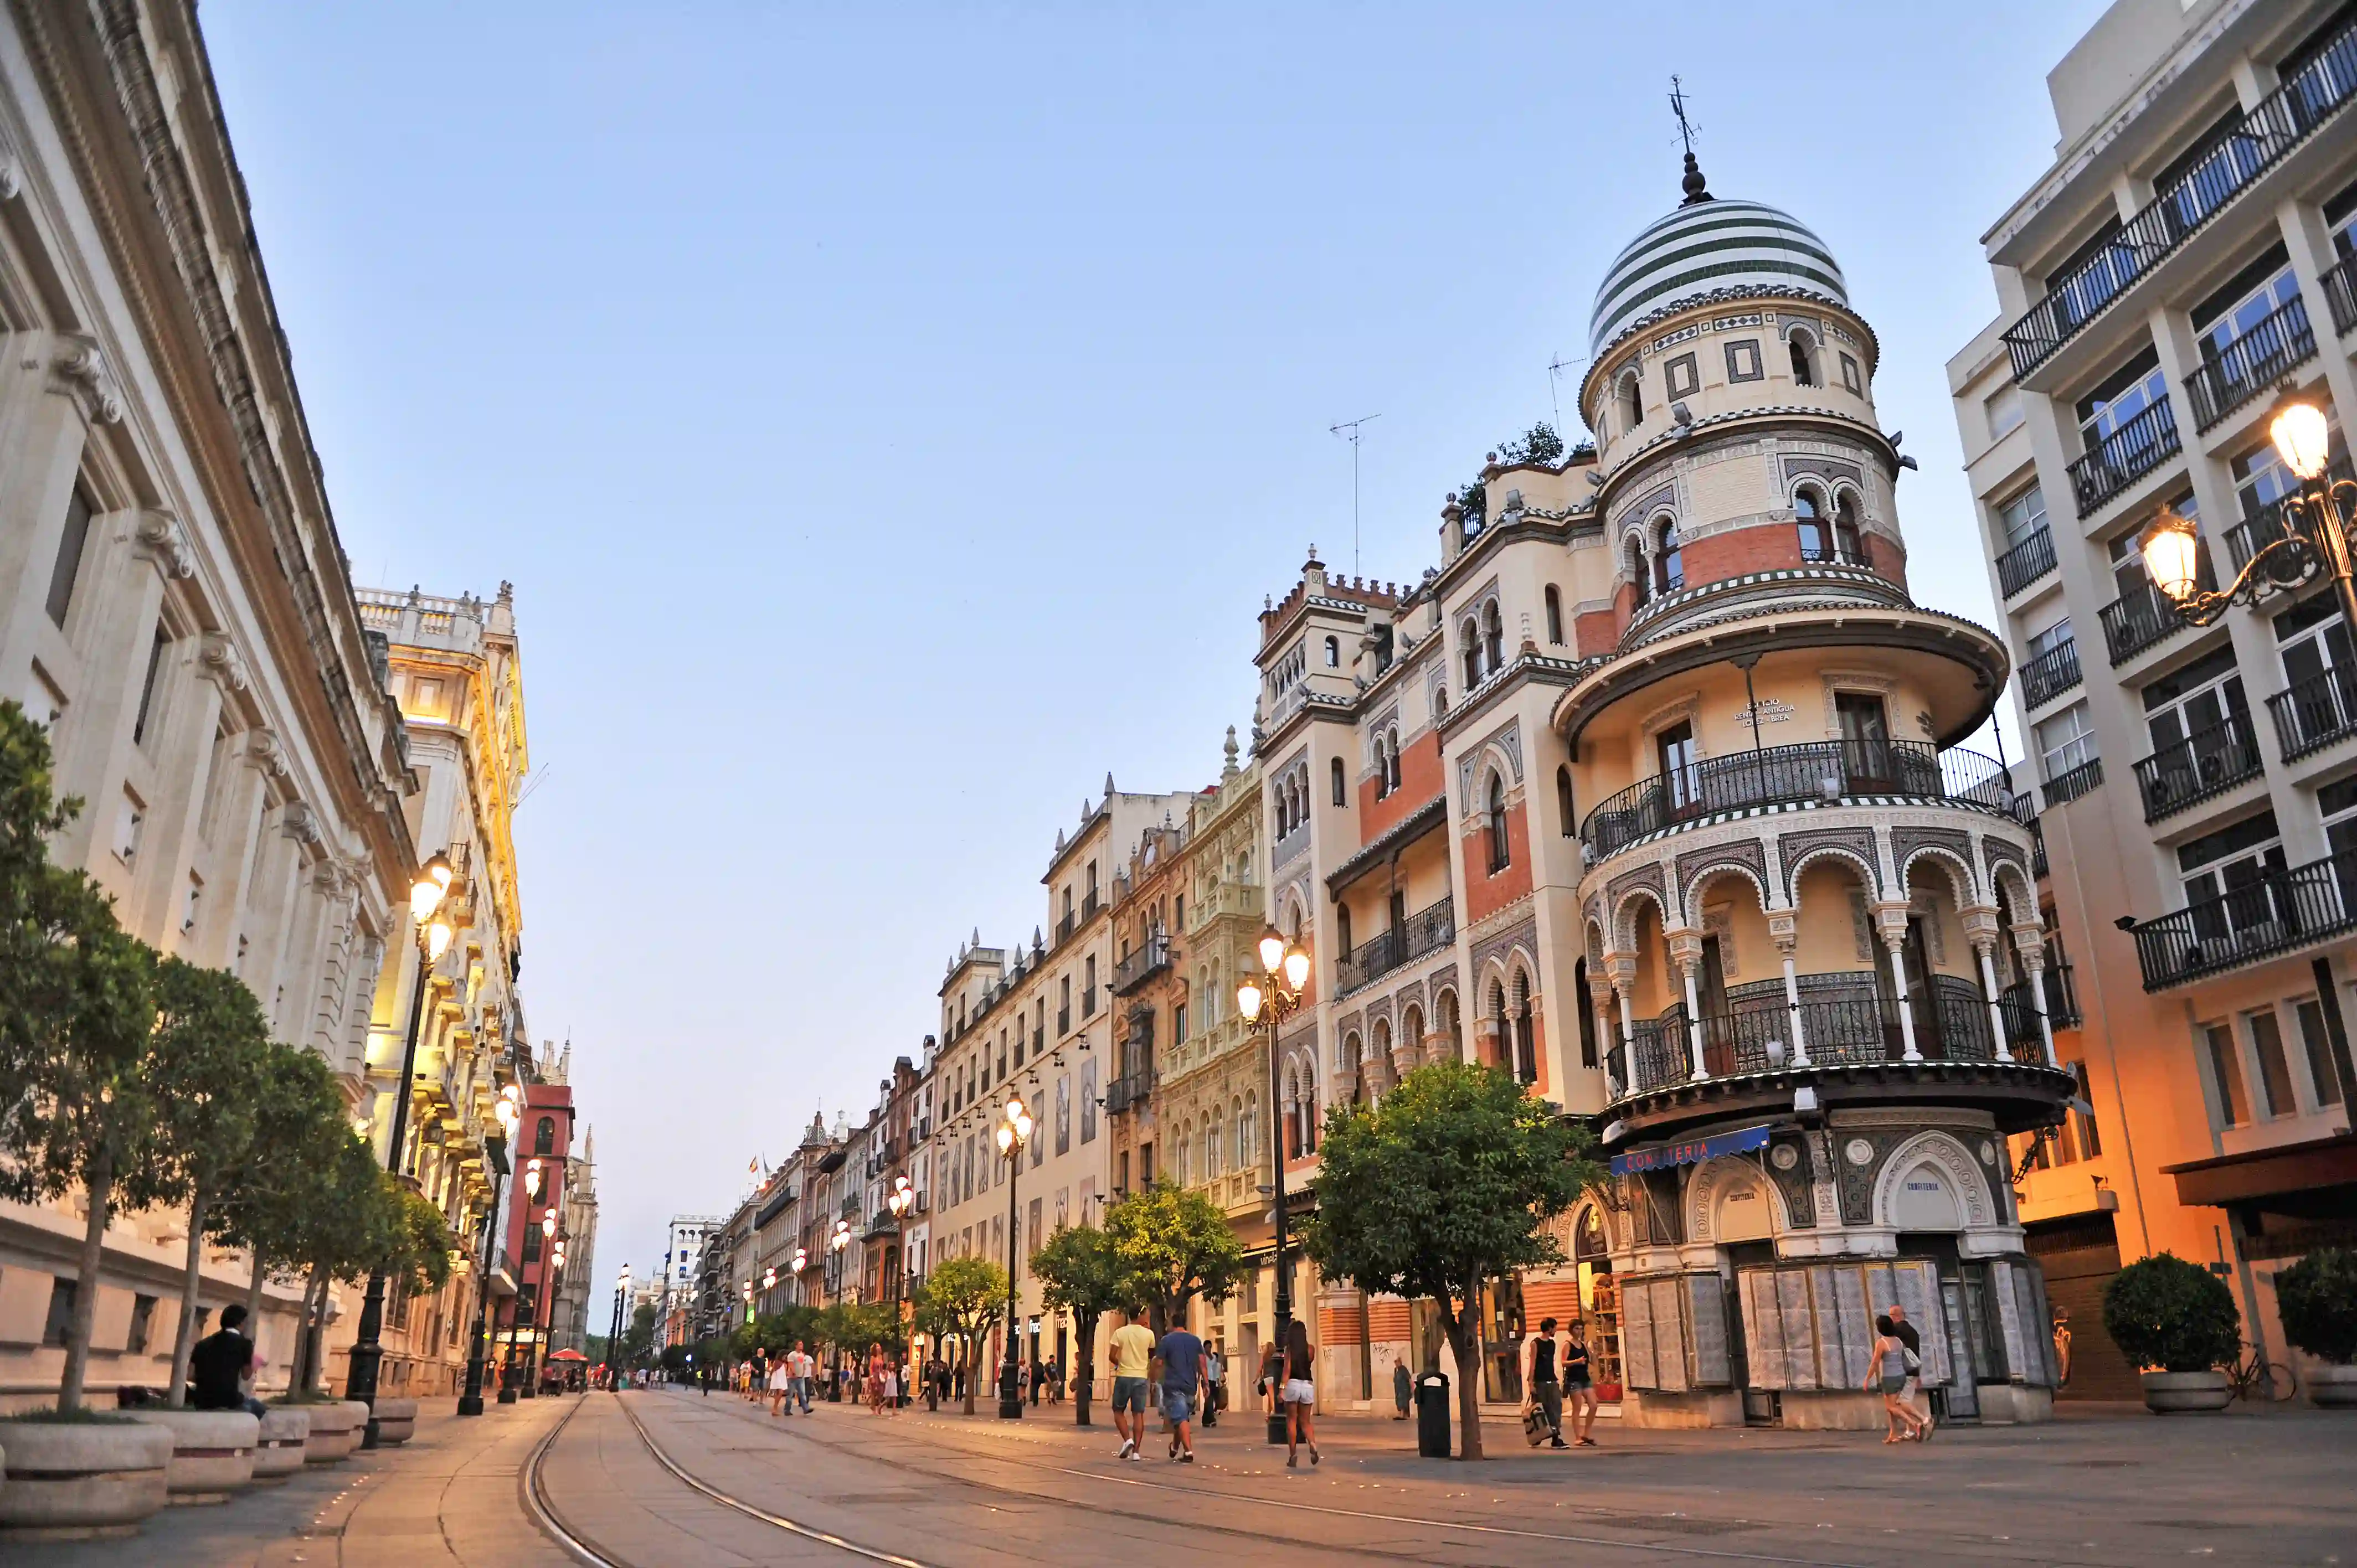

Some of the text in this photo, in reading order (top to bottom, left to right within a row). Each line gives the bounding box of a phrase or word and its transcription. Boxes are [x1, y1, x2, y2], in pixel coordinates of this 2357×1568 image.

[1763, 704, 1795, 715] ANTIGUA
[1771, 714, 1789, 723] BREA
[1028, 1319, 1041, 1333] fnac
